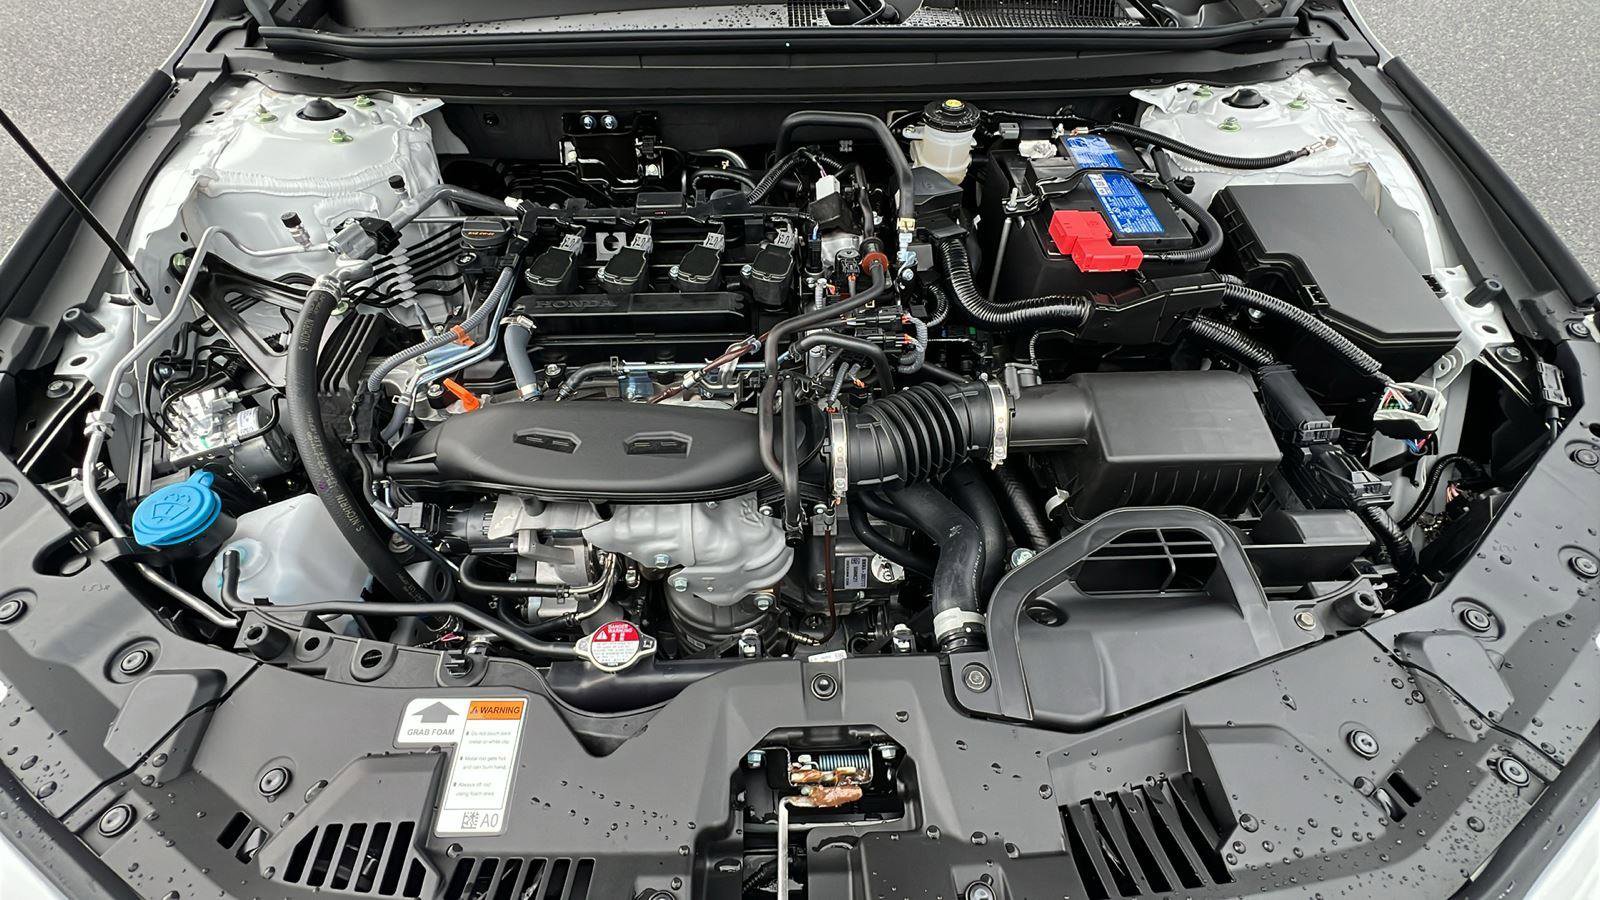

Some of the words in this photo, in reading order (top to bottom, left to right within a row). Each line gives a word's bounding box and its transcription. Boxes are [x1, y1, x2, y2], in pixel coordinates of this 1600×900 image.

[534, 300, 617, 308] HONDA
[480, 706, 520, 714] WARNING
[480, 813, 499, 828] A0
